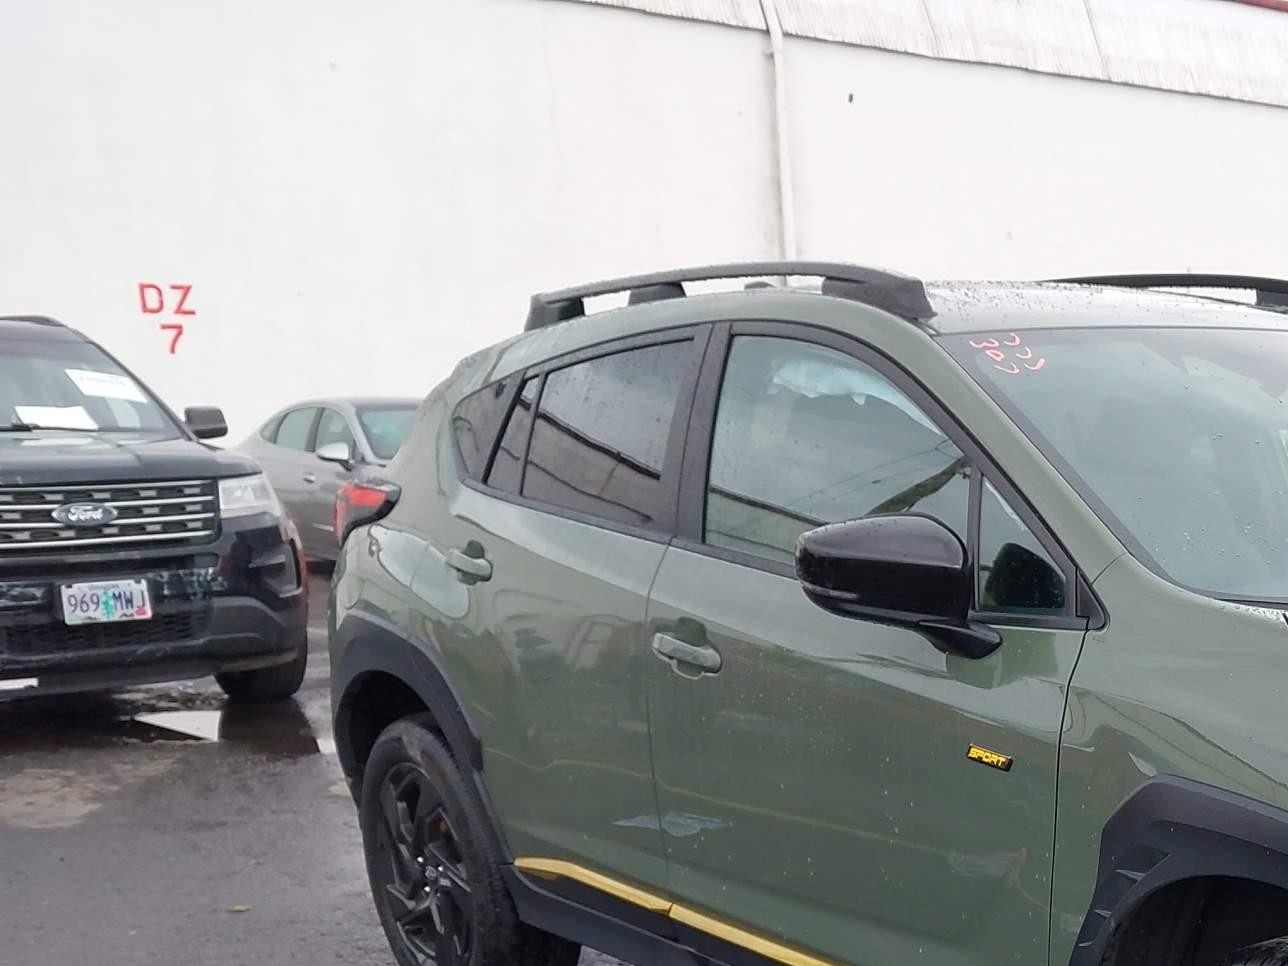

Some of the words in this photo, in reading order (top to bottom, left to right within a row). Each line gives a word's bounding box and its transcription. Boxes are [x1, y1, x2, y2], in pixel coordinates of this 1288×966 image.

[138, 283, 196, 315] DZ
[160, 323, 183, 354] 7
[68, 505, 104, 521] Ford
[67, 593, 101, 613] 969
[112, 590, 146, 611] MWJ
[968, 747, 1008, 767] SPORT
